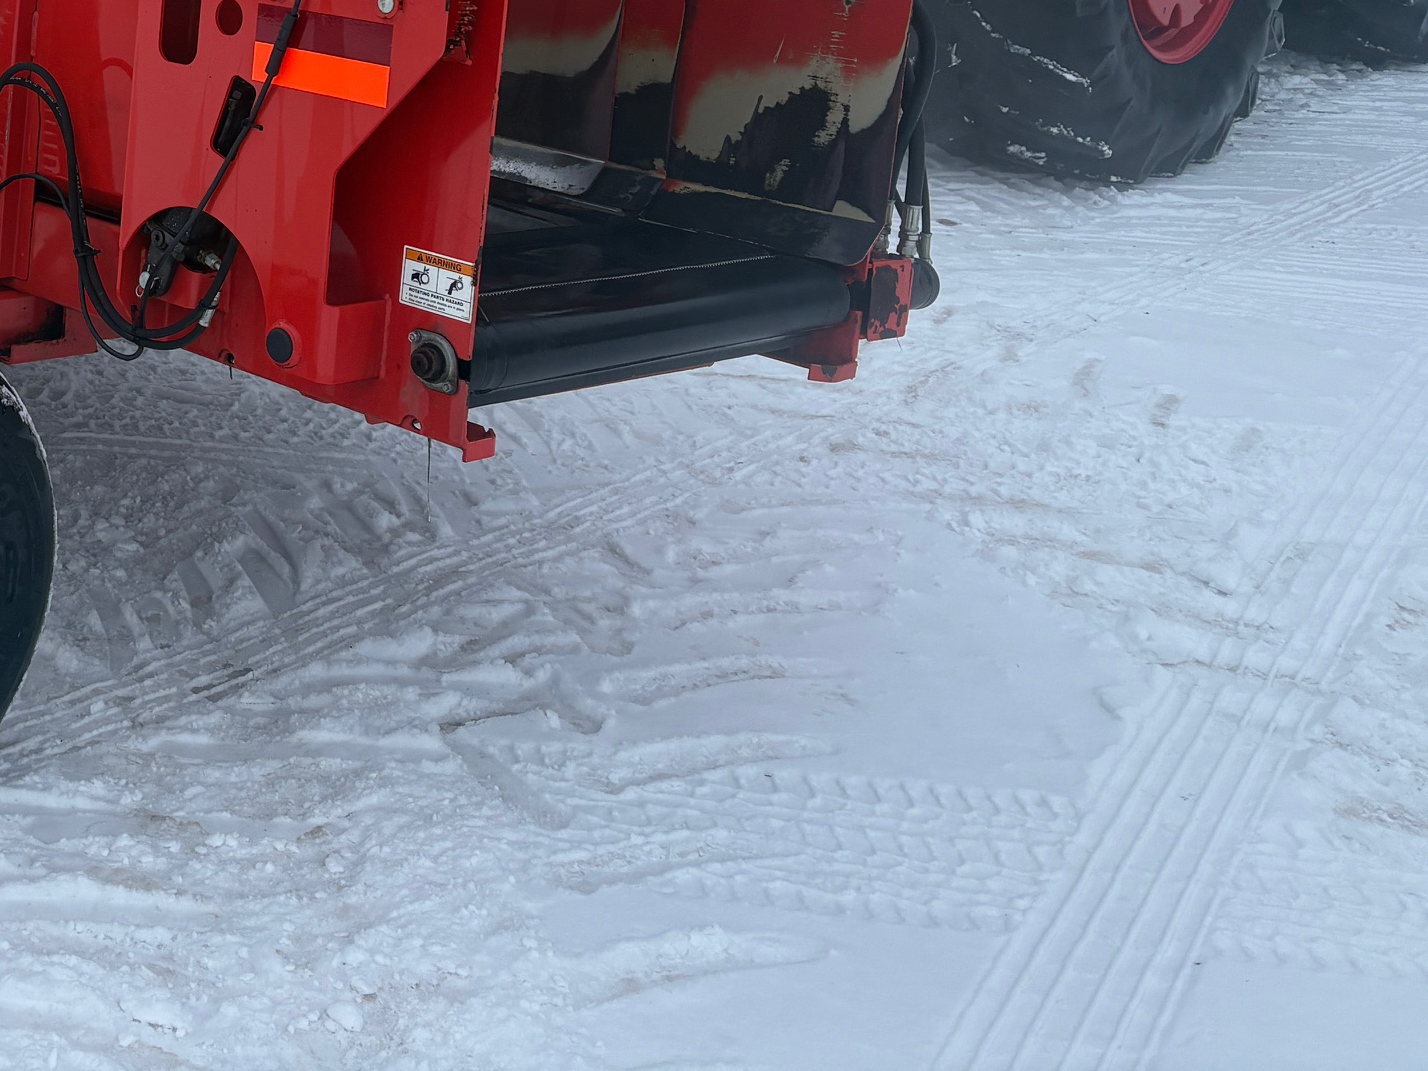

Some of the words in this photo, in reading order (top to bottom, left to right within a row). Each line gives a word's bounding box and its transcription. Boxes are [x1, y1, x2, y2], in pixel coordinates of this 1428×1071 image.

[425, 255, 462, 272] WARNING
[409, 287, 430, 297] ROTATING
[446, 298, 464, 307] HAZARD
